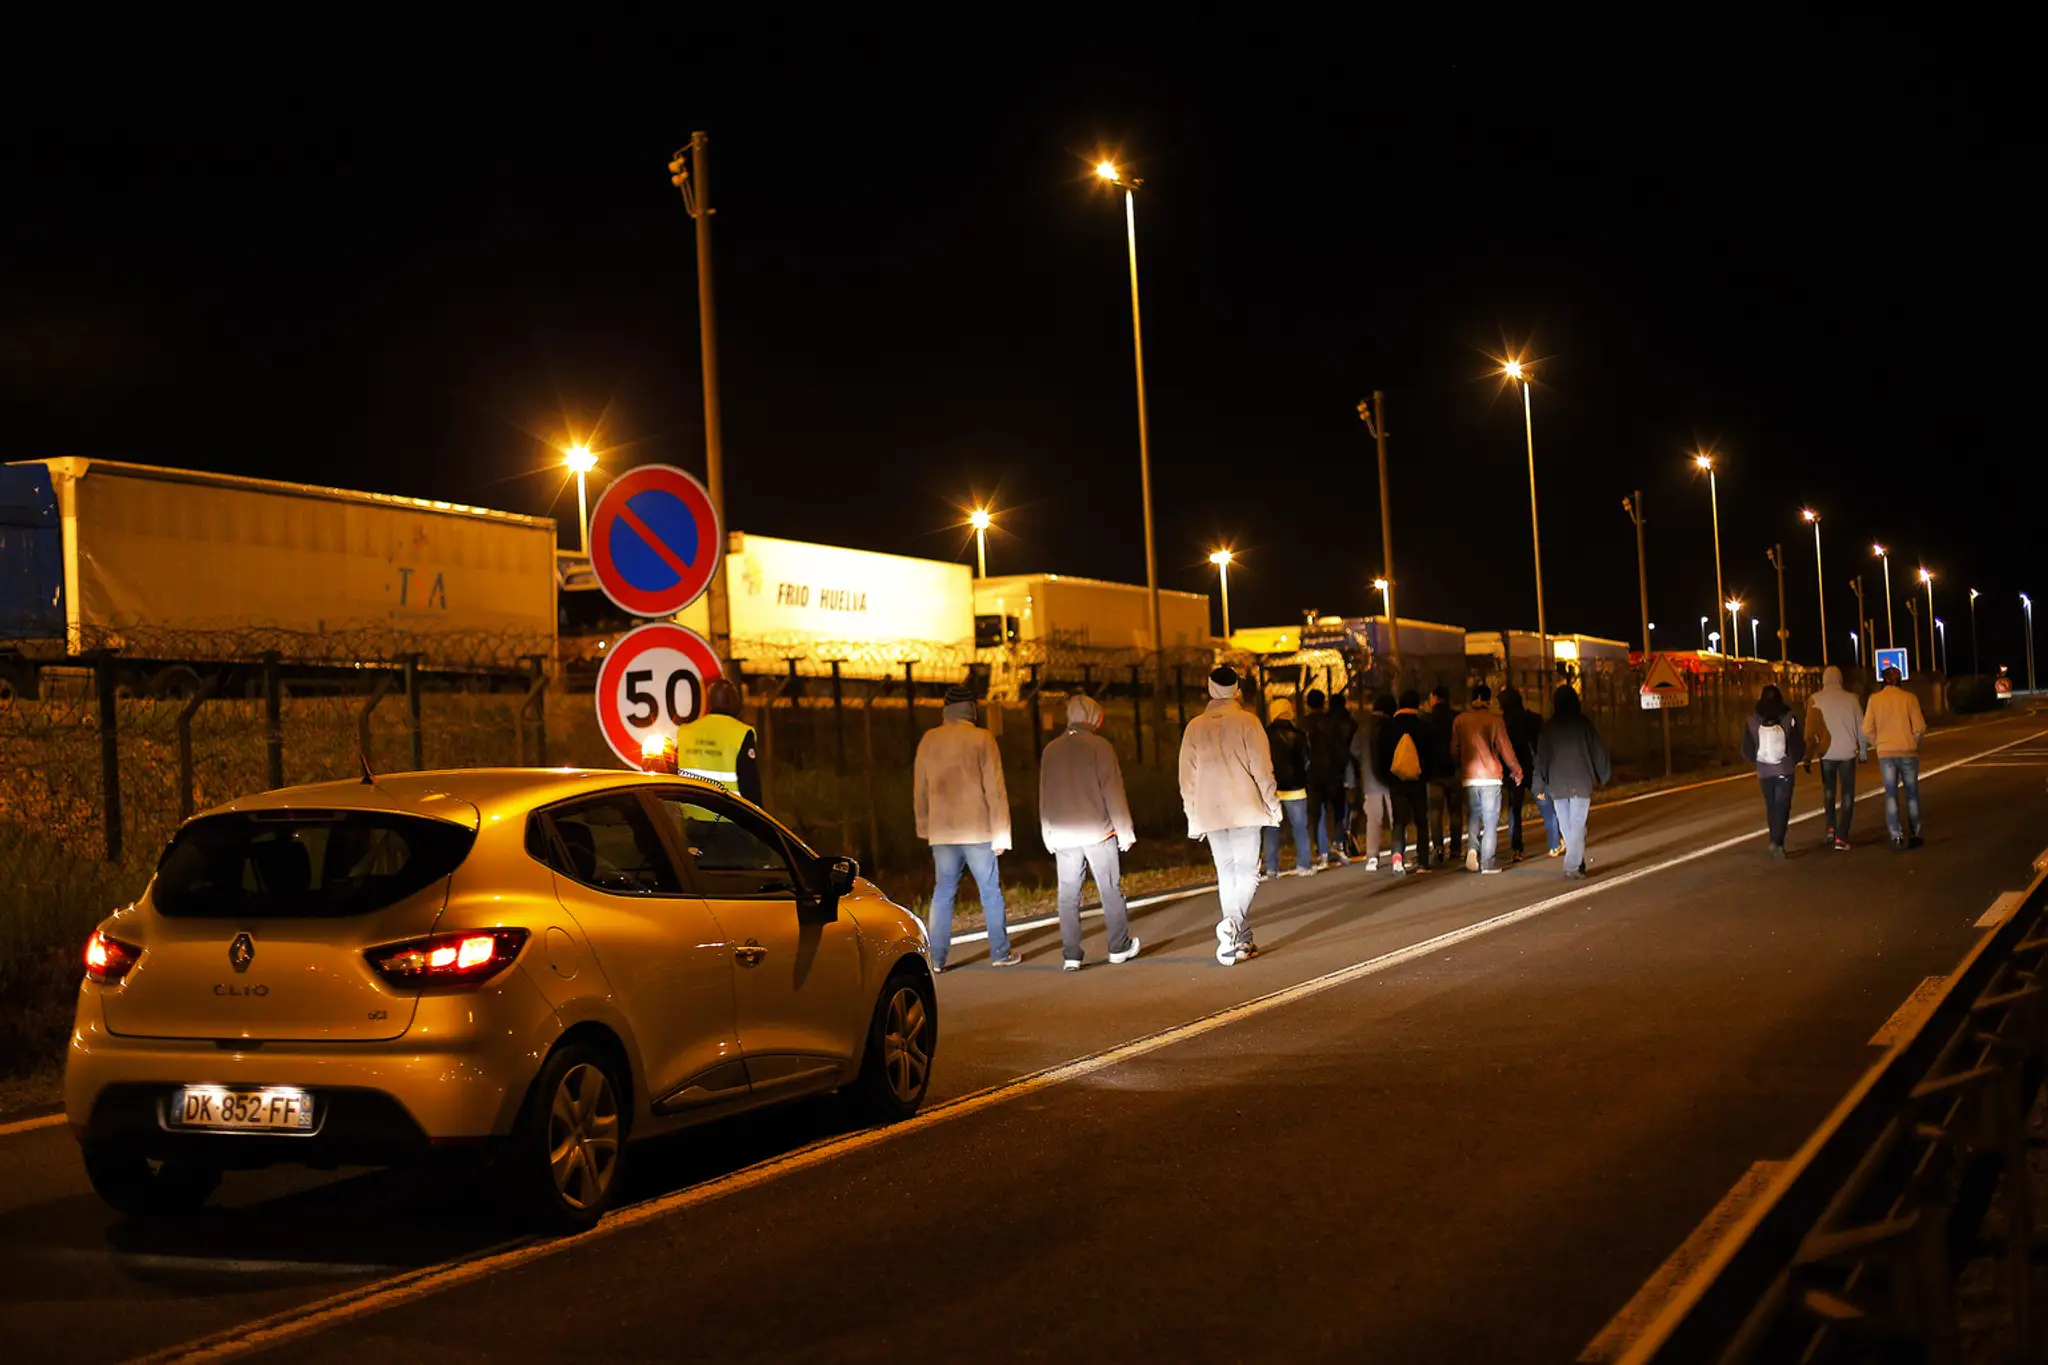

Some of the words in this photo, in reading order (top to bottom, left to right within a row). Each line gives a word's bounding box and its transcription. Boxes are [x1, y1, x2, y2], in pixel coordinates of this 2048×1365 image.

[777, 583, 809, 607] FRIO
[626, 669, 701, 728] 50
[213, 984, 270, 997] CLIO
